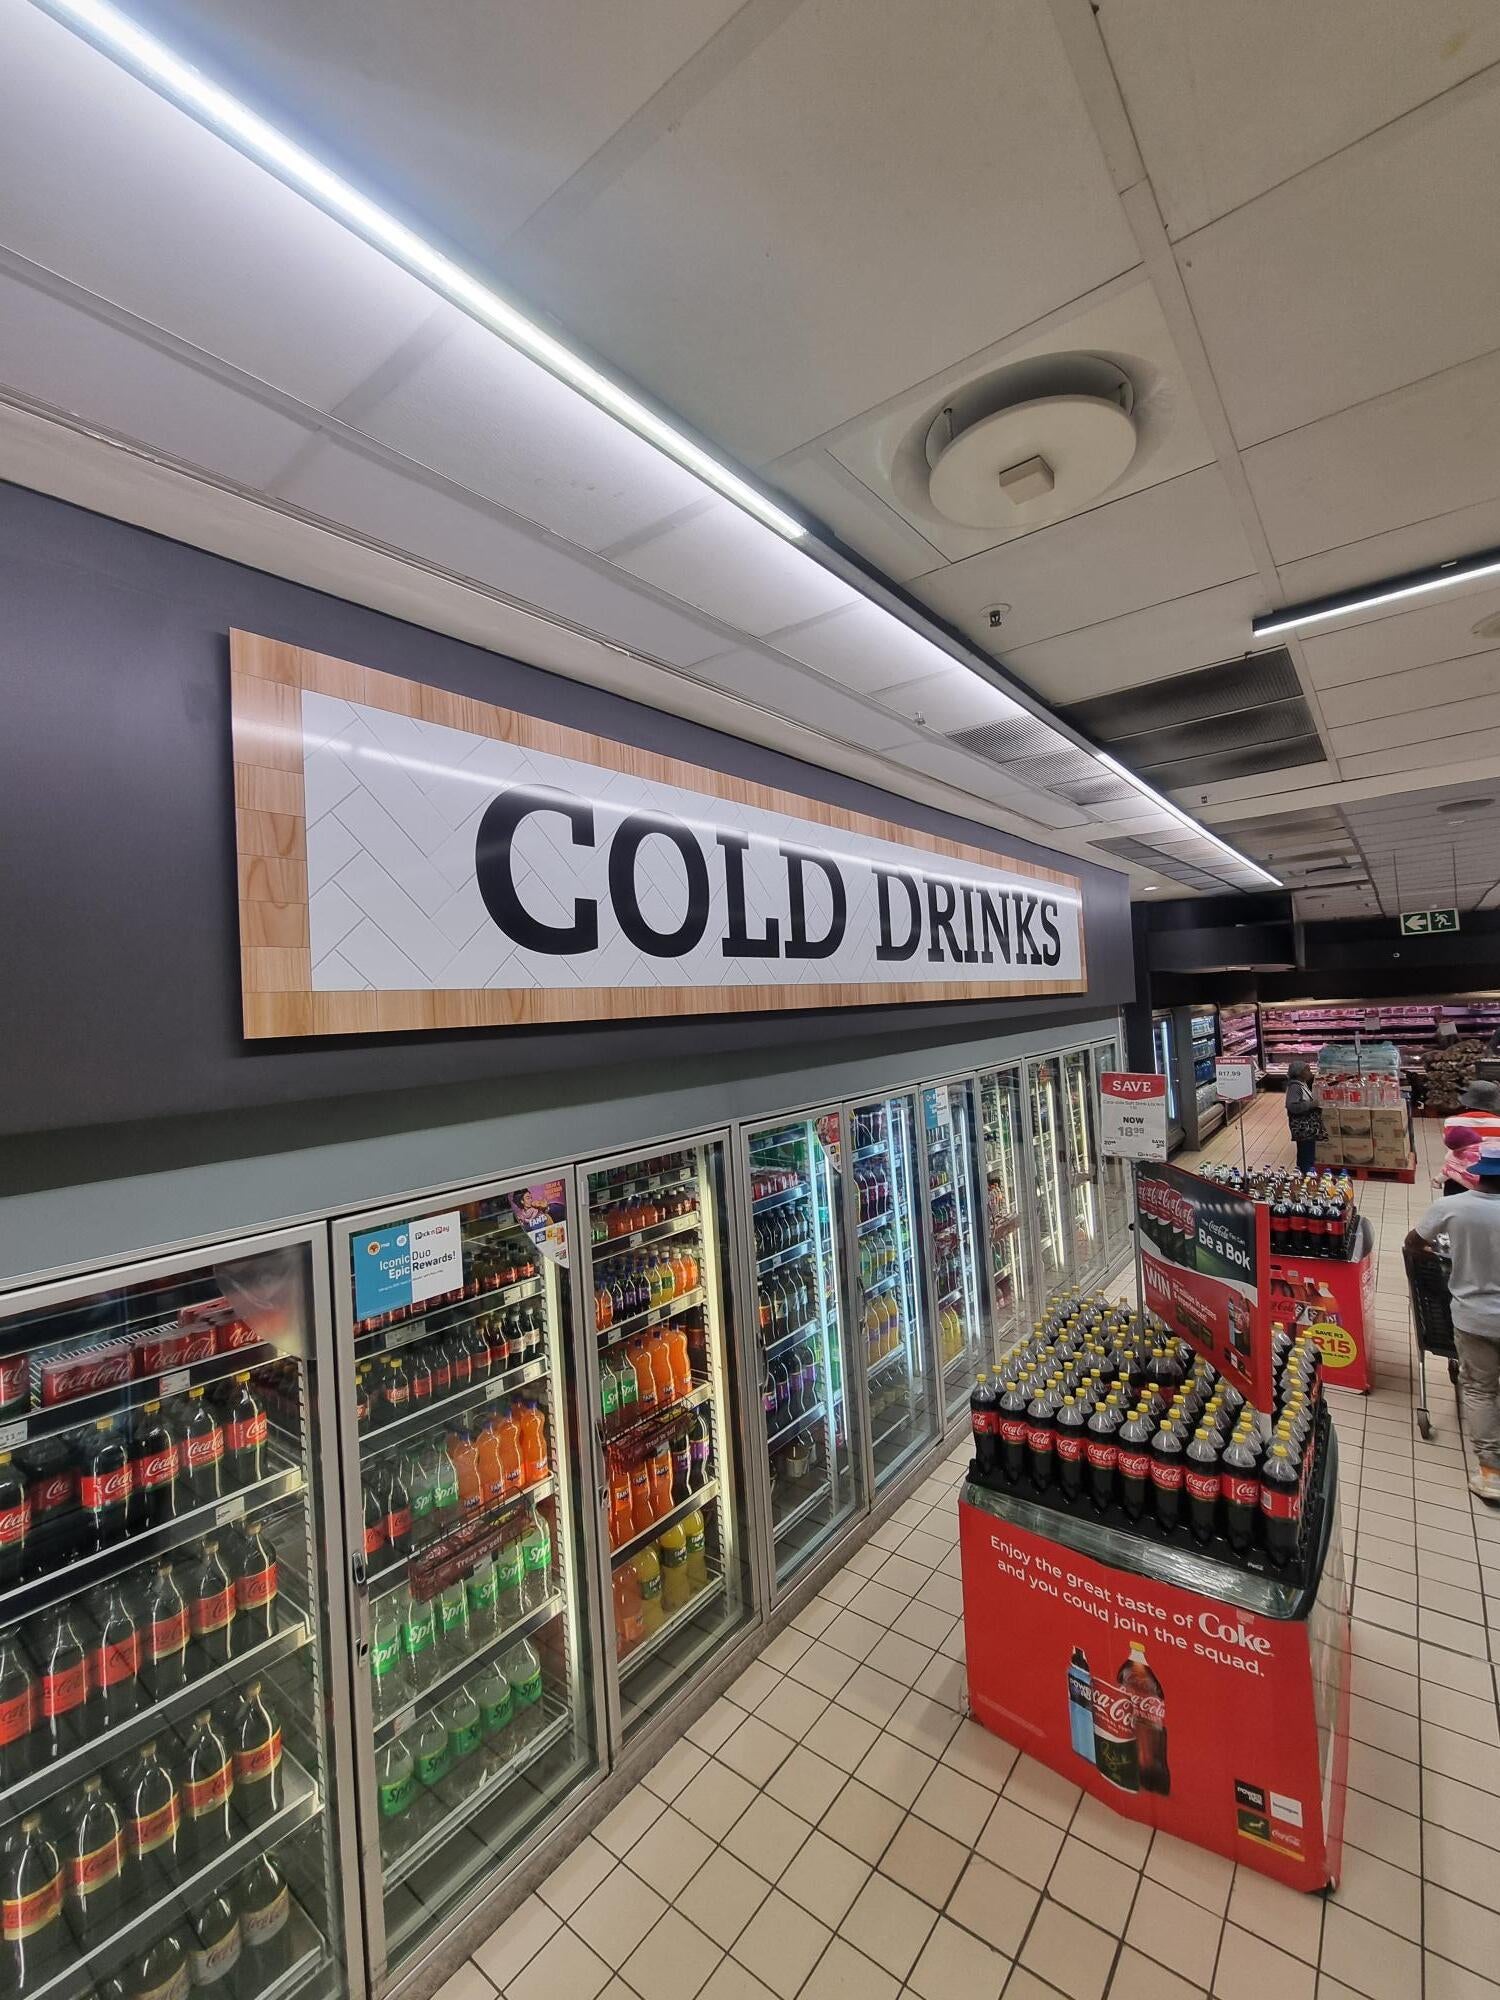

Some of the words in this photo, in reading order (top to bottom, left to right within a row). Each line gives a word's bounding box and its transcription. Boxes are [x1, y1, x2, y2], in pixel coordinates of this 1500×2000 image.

[475, 783, 847, 959] COLD
[871, 859, 1061, 966] DRINKS
[1112, 1080, 1152, 1093] SAVE
[379, 1254, 411, 1271] Iconic
[412, 1249, 431, 1261] Duo
[1198, 1227, 1214, 1249] Be
[1215, 1240, 1224, 1255] a
[1225, 1242, 1252, 1271] Bok
[389, 1266, 411, 1280] Epic
[412, 1250, 456, 1272] Rewards!
[1145, 1264, 1172, 1301] WIN
[1311, 1336, 1351, 1354] R15
[1315, 1329, 1332, 1337] SAVE
[456, 1552, 477, 1569] Treat
[991, 1535, 1031, 1566] Enjoy
[1035, 1556, 1062, 1578] the
[1066, 1571, 1112, 1603] great
[1116, 1591, 1167, 1621] taste
[1173, 1611, 1194, 1629] of
[1198, 1612, 1272, 1656] Coke
[997, 1559, 1025, 1582] and
[1030, 1573, 1058, 1598] you
[1063, 1590, 1109, 1623] could
[1113, 1611, 1149, 1637] join
[1154, 1626, 1187, 1649] the
[1193, 1642, 1265, 1677] squad.
